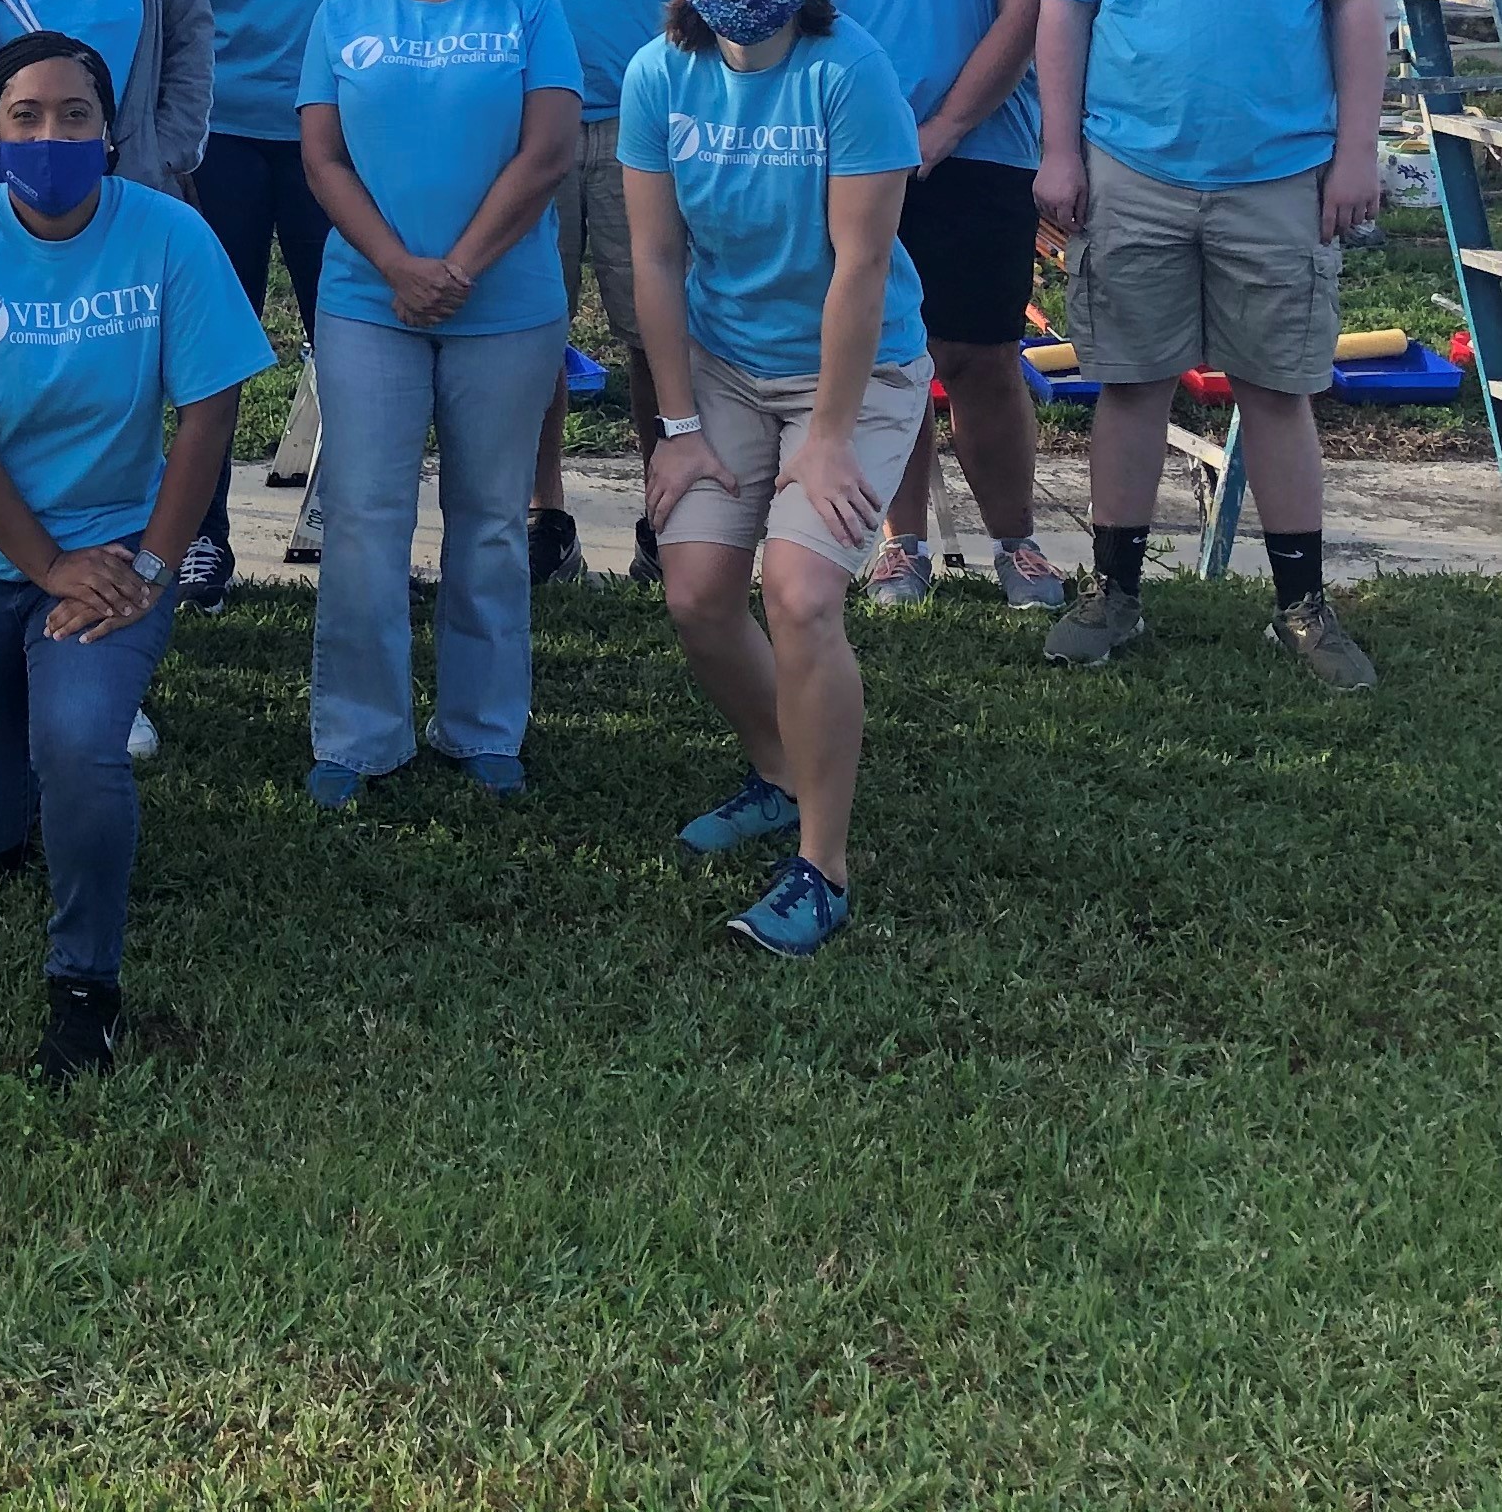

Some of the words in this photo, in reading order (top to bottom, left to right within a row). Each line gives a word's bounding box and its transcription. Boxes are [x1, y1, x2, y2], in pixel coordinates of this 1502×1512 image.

[389, 29, 523, 58] VELOCITY
[382, 53, 447, 68] community
[451, 50, 485, 65] credit
[489, 51, 519, 64] union
[704, 122, 827, 151] VELOCITY
[762, 150, 798, 166] credit
[11, 283, 159, 329] VELOCITY
[9, 327, 81, 346] community
[86, 319, 123, 338] credit
[128, 313, 160, 331] union
